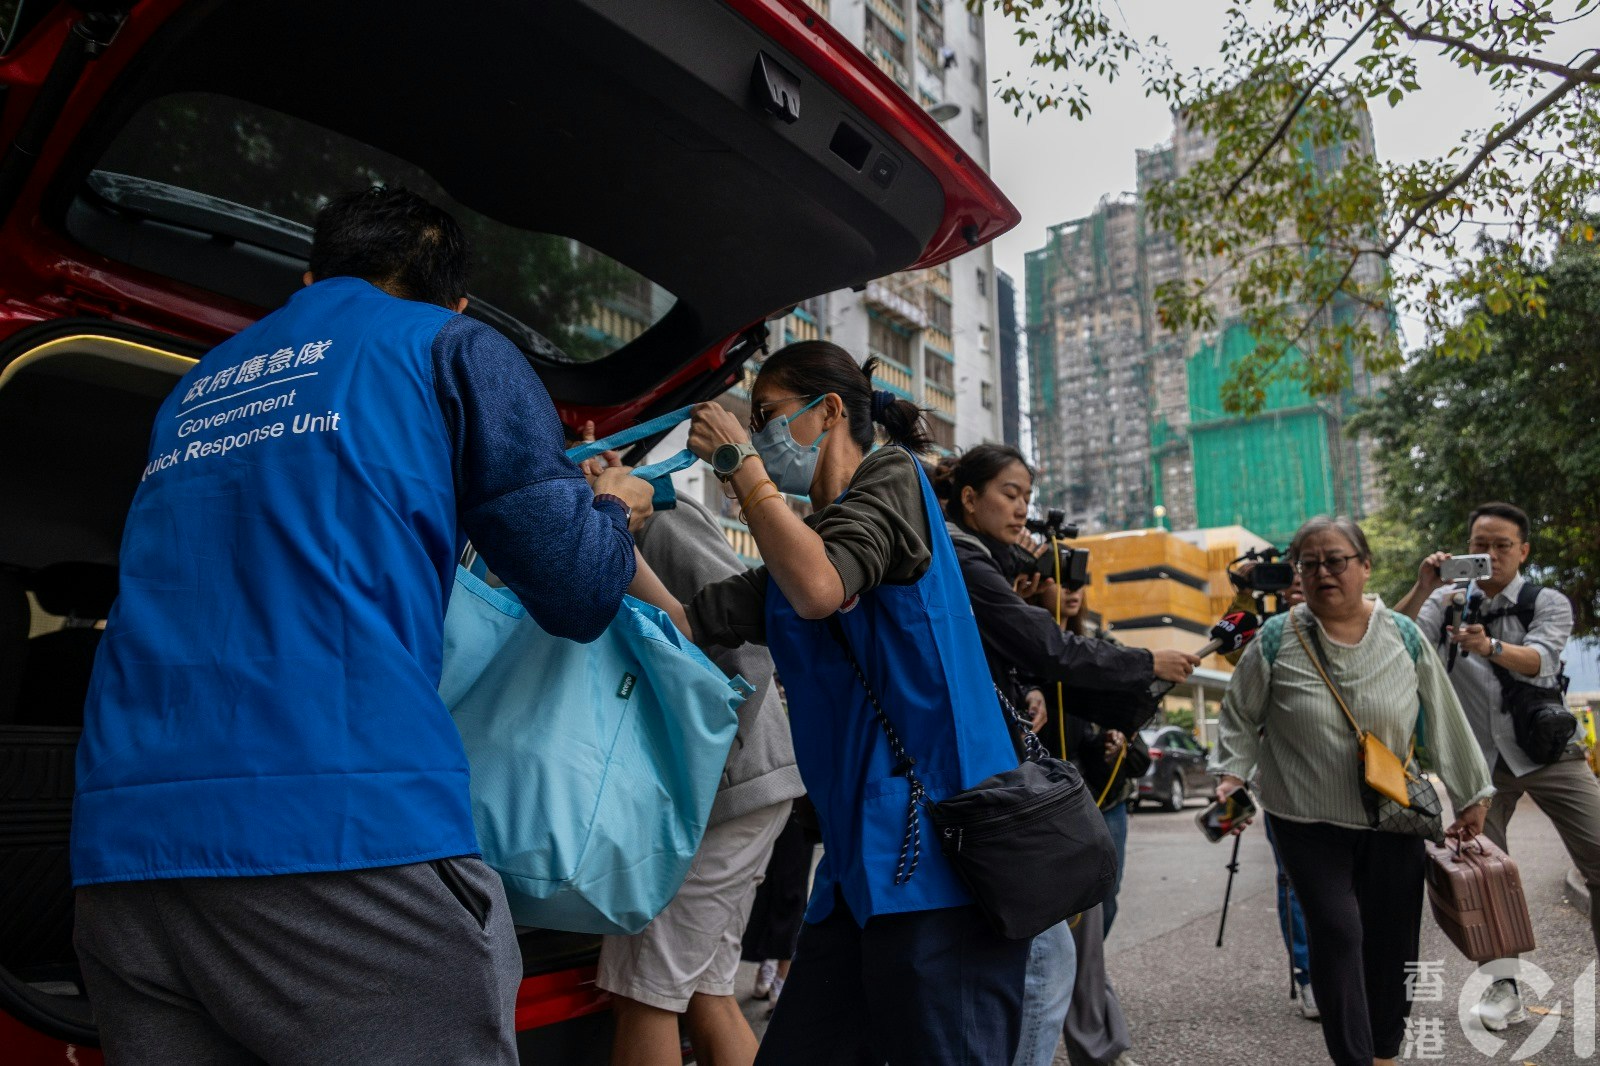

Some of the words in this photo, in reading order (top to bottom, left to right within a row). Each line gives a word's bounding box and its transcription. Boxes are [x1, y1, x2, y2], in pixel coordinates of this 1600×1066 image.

[181, 339, 333, 405] 政府應急隊
[141, 448, 182, 482] uick
[184, 421, 285, 461] Response
[292, 410, 341, 434] Unit
[177, 388, 297, 438] Government
